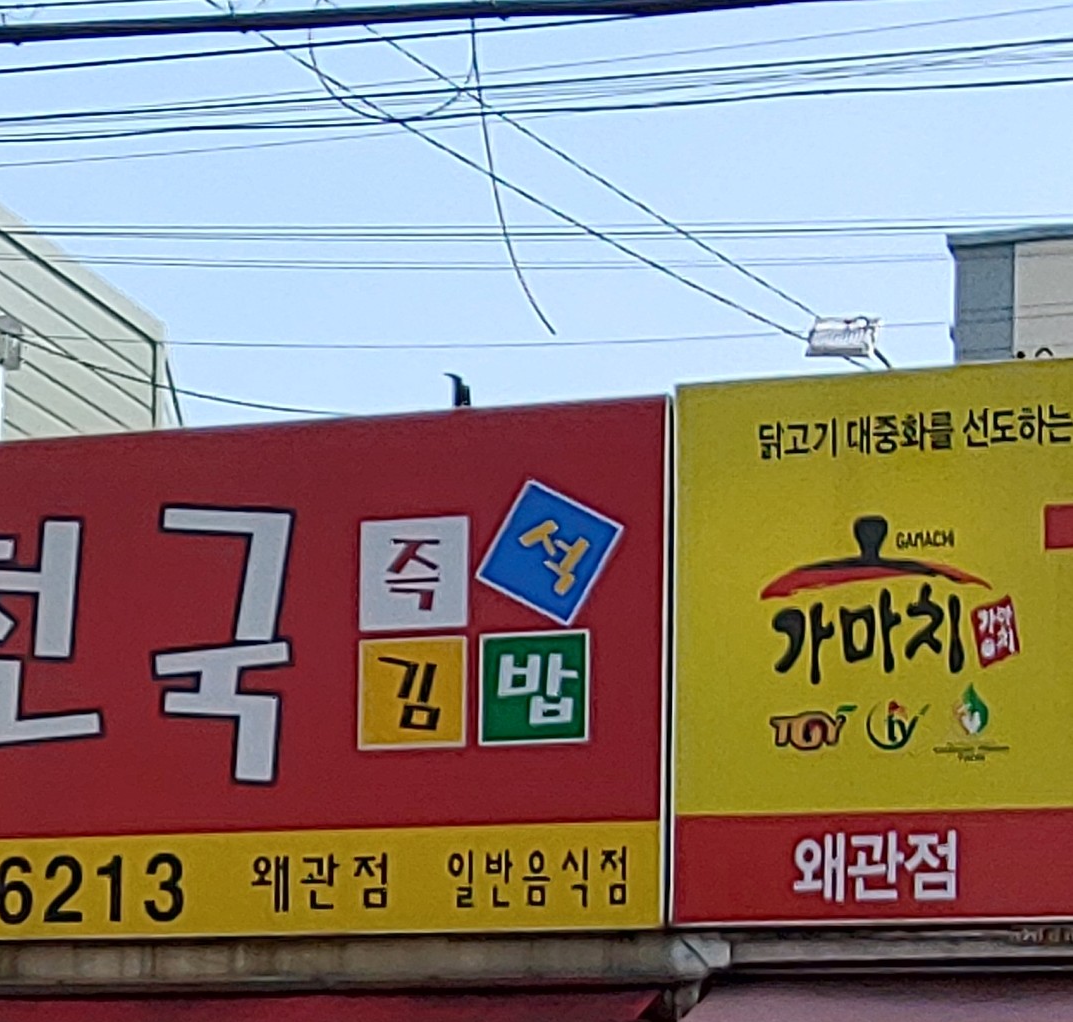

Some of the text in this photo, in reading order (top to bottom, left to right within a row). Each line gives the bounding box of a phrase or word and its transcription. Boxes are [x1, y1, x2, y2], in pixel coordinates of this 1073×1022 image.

[758, 404, 1073, 459] 닭고기 대중화를 선도하는
[771, 582, 966, 686] 가마치
[251, 852, 389, 913] 왜관점
[447, 845, 628, 909] 일반음식점
[794, 830, 957, 902] 왜관점
